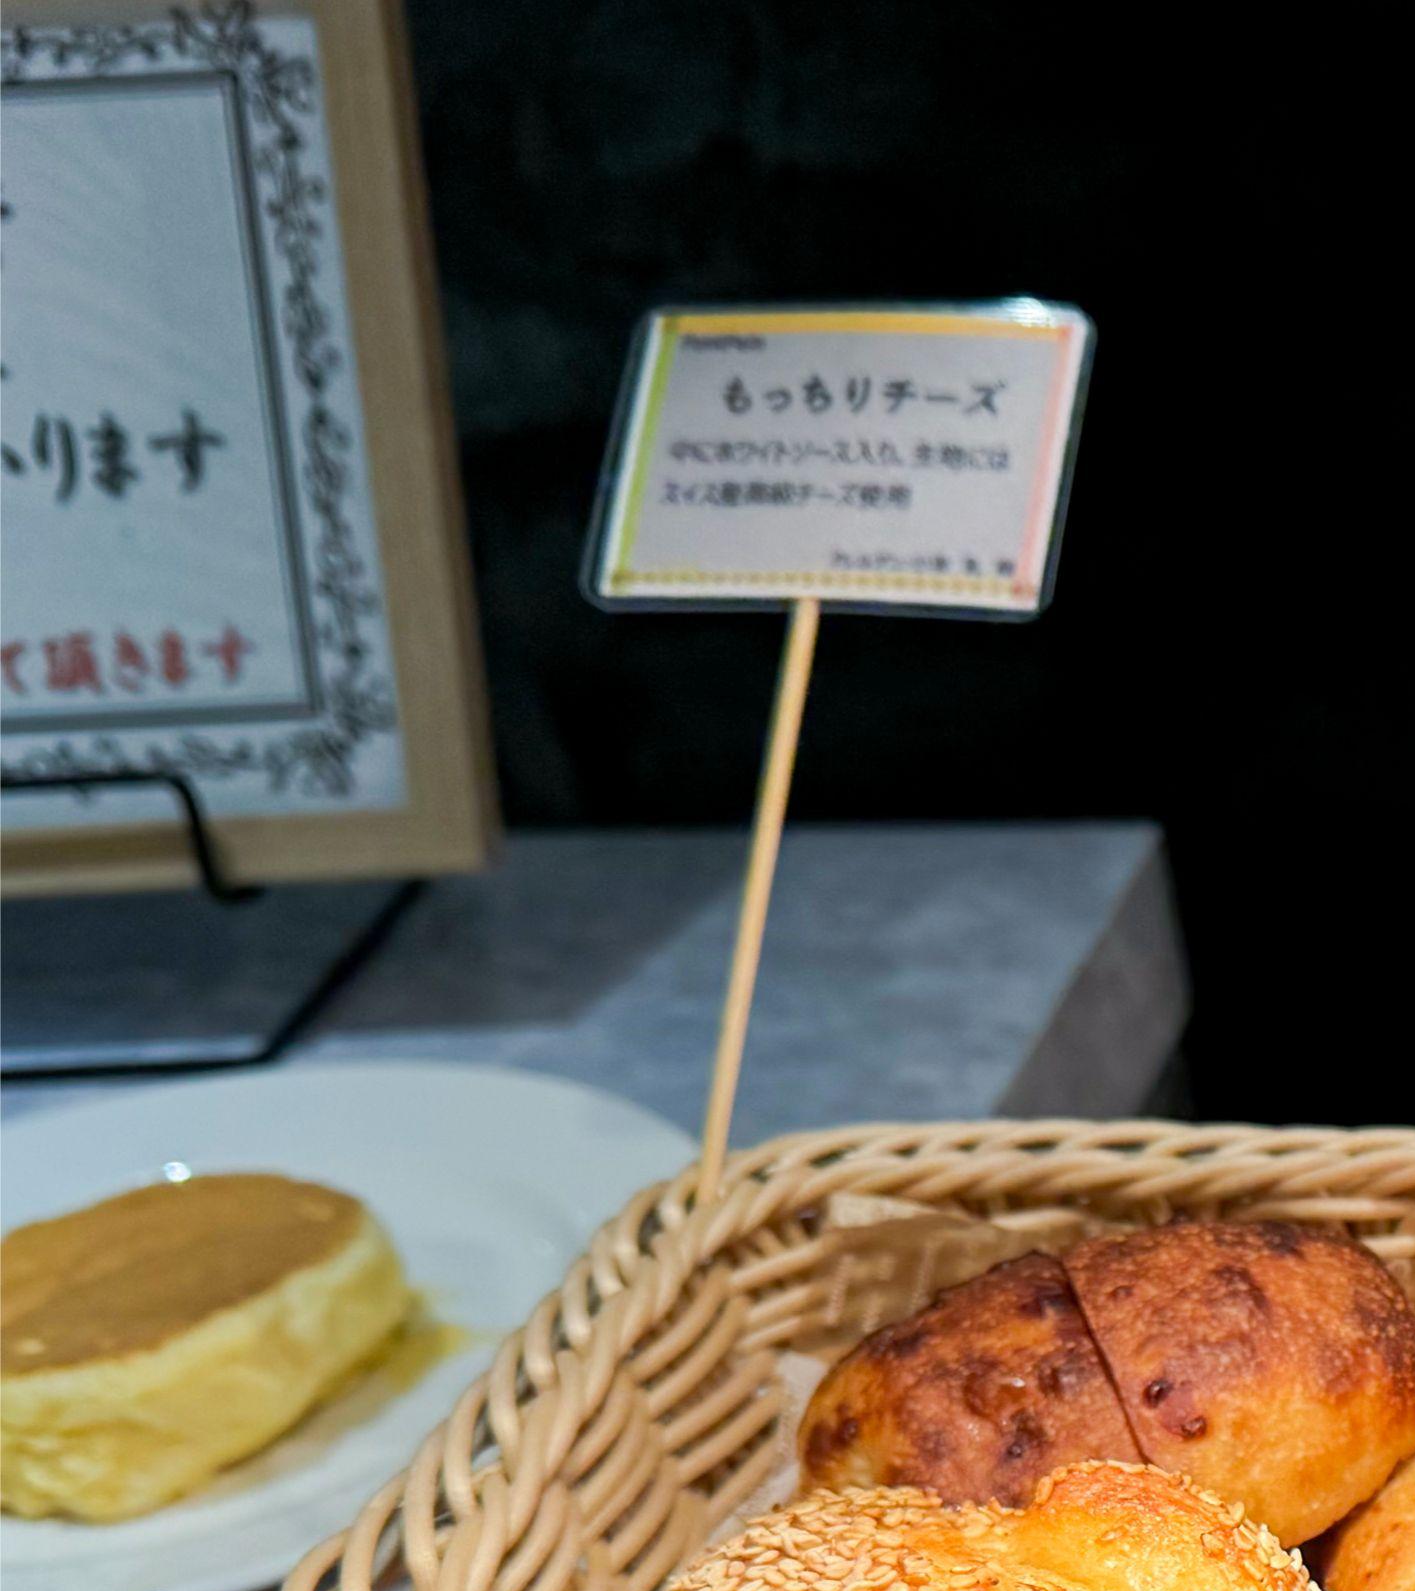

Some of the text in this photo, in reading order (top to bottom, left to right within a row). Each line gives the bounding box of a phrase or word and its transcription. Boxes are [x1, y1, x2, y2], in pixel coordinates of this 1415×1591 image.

[723, 375, 1005, 416] もっちりチーズ
[0, 405, 228, 505] ります
